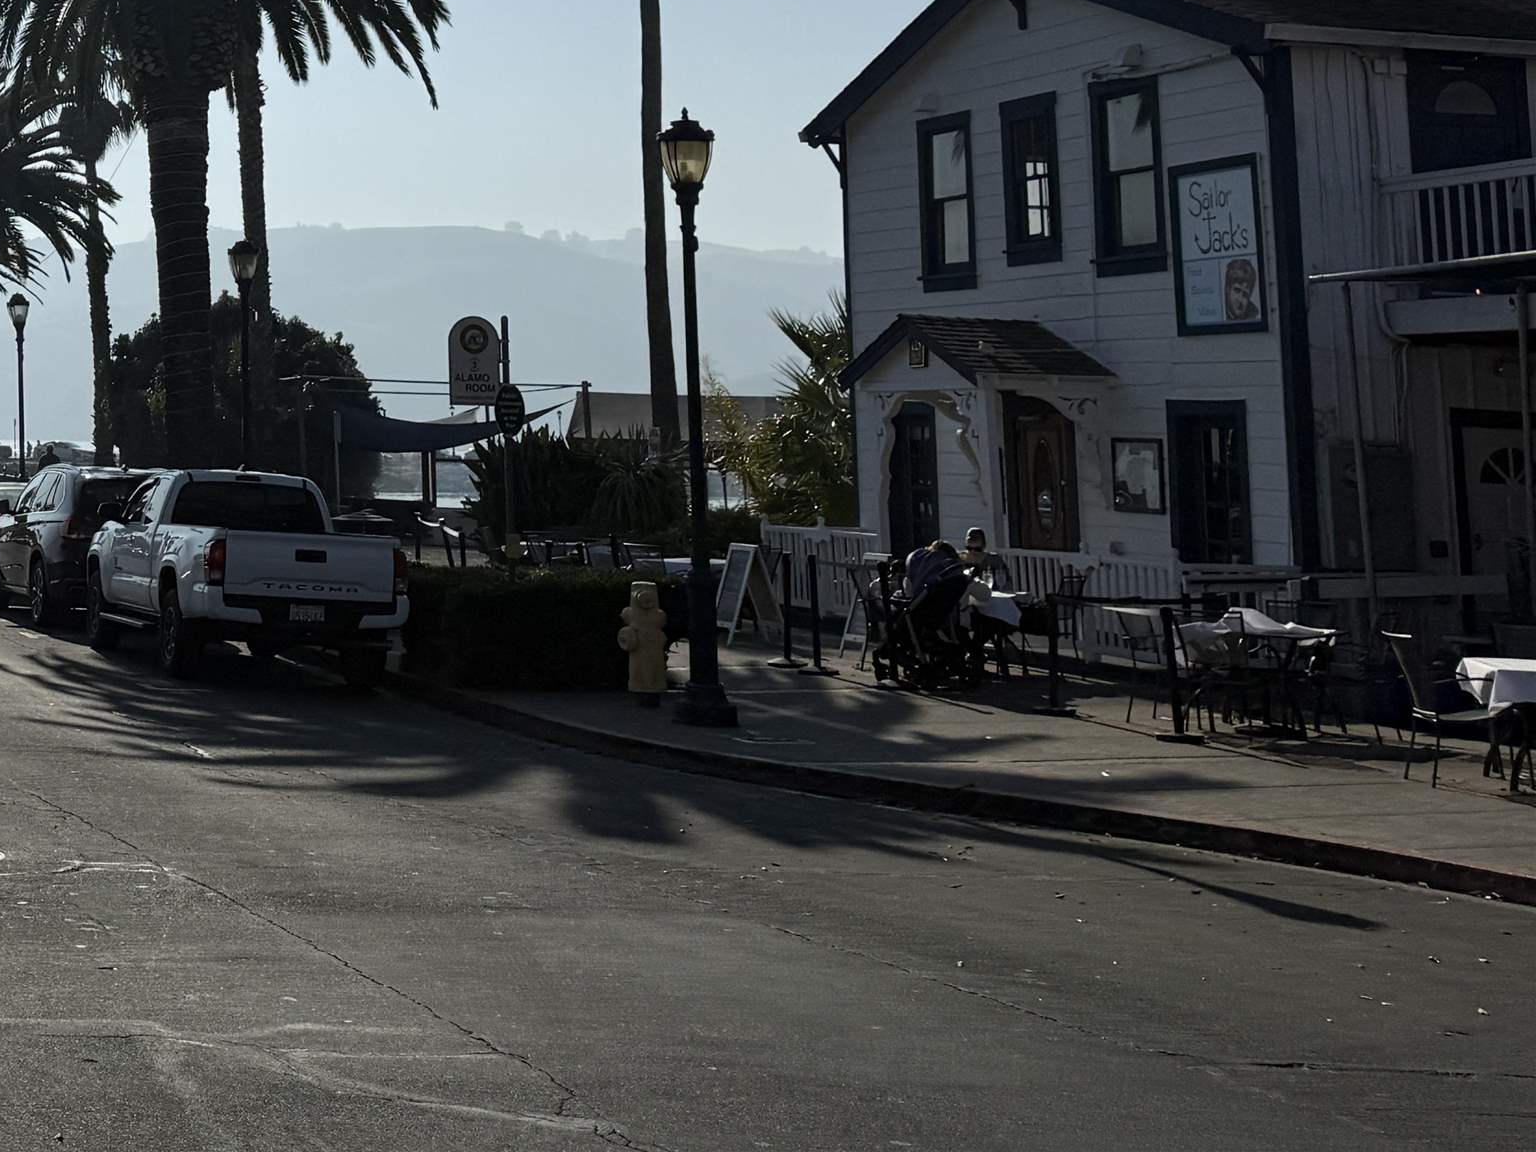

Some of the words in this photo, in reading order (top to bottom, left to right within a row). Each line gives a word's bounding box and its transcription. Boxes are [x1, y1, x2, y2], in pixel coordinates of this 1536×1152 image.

[1188, 180, 1232, 217] Sailor
[1194, 211, 1248, 254] Jack's
[465, 383, 496, 393] ROOM
[264, 582, 359, 593] TACOMA
